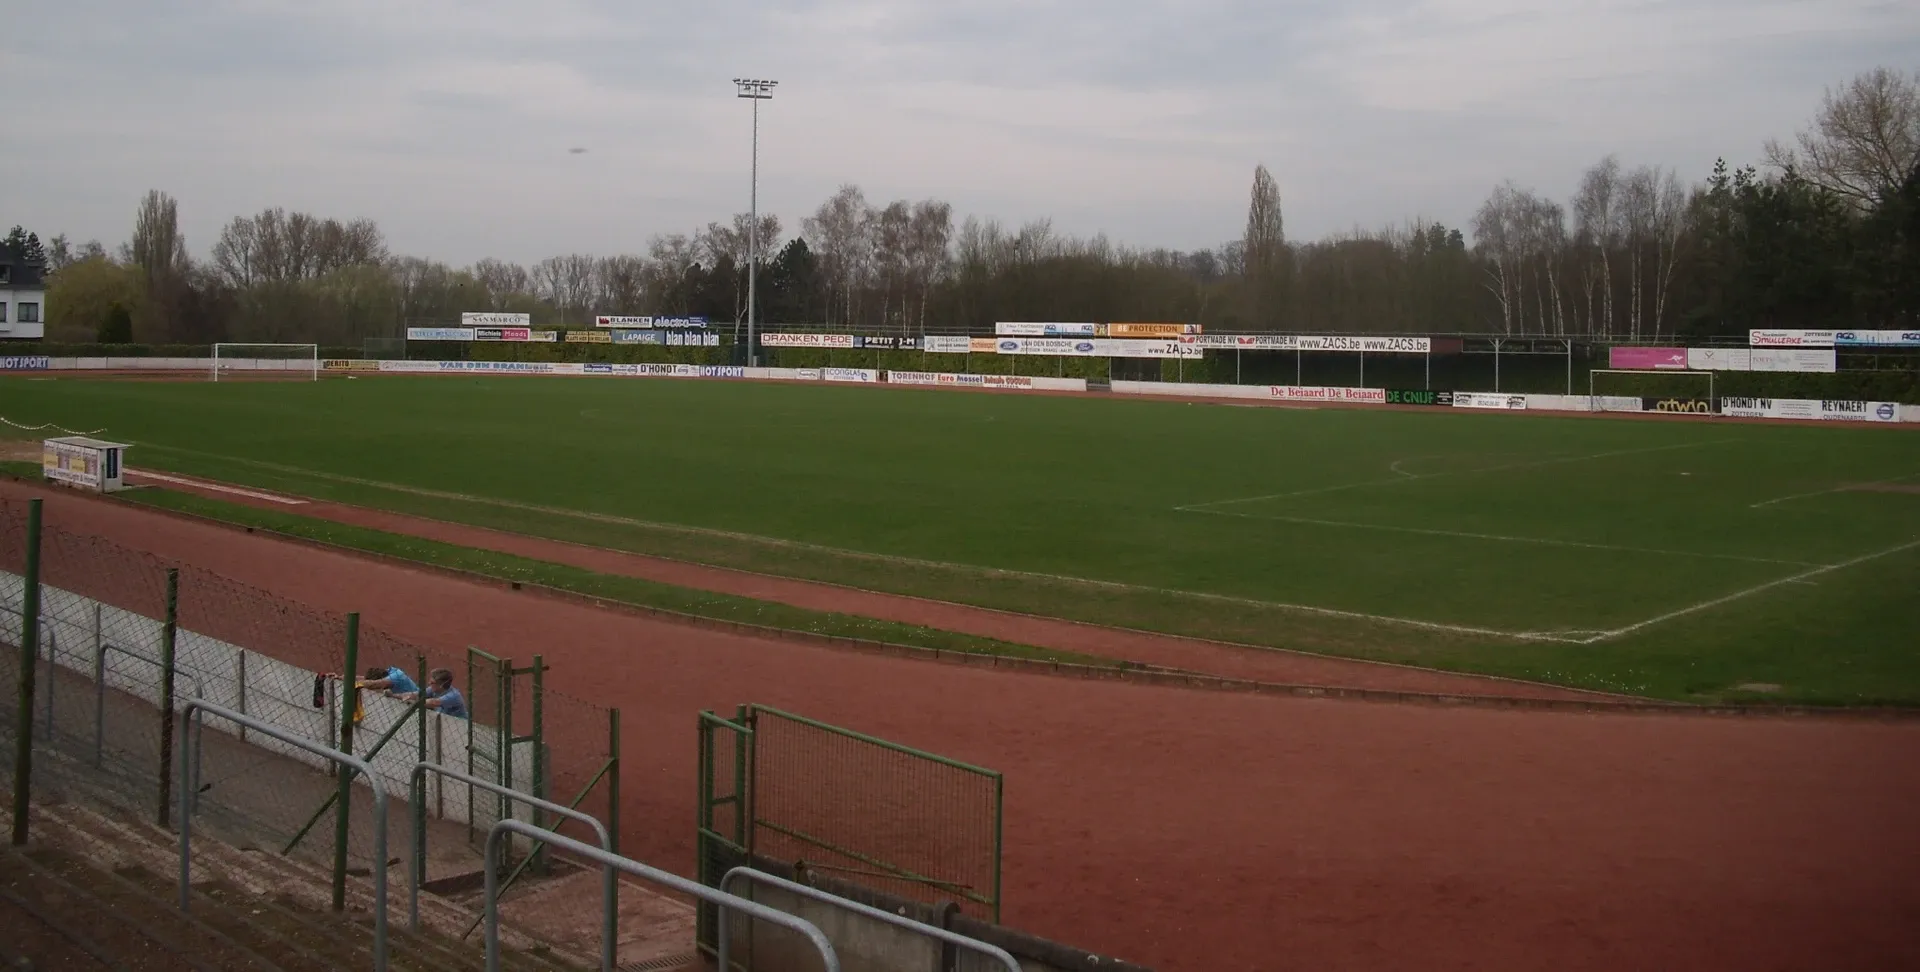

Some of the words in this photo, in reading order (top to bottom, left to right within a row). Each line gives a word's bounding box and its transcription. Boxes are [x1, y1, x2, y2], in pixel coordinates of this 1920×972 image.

[1129, 325, 1177, 333] PROTECTION
[666, 331, 683, 345] blan
[684, 331, 702, 345] blan
[703, 332, 720, 346] blan
[763, 334, 819, 342] DRANKEN
[865, 337, 894, 345] PETIT
[1196, 336, 1226, 344] PORTMADE
[1228, 336, 1237, 344] NV
[1255, 336, 1287, 345] PORTMADE
[1288, 336, 1298, 345] NV
[1300, 337, 1360, 350] www.ZACS.be
[1364, 338, 1428, 351] www.ZACS.be
[641, 365, 677, 374] D'HONDT
[892, 373, 935, 381] TORENHOF
[937, 374, 954, 382] Euro
[1271, 387, 1284, 396] De
[1288, 388, 1325, 397] Beiaard
[1327, 388, 1341, 397] De
[1345, 389, 1384, 399] Beiaard
[1387, 391, 1400, 402] DE
[1723, 397, 1757, 408] D'HONDT
[1760, 398, 1772, 409] NV
[1822, 401, 1867, 412] REYNAERT
